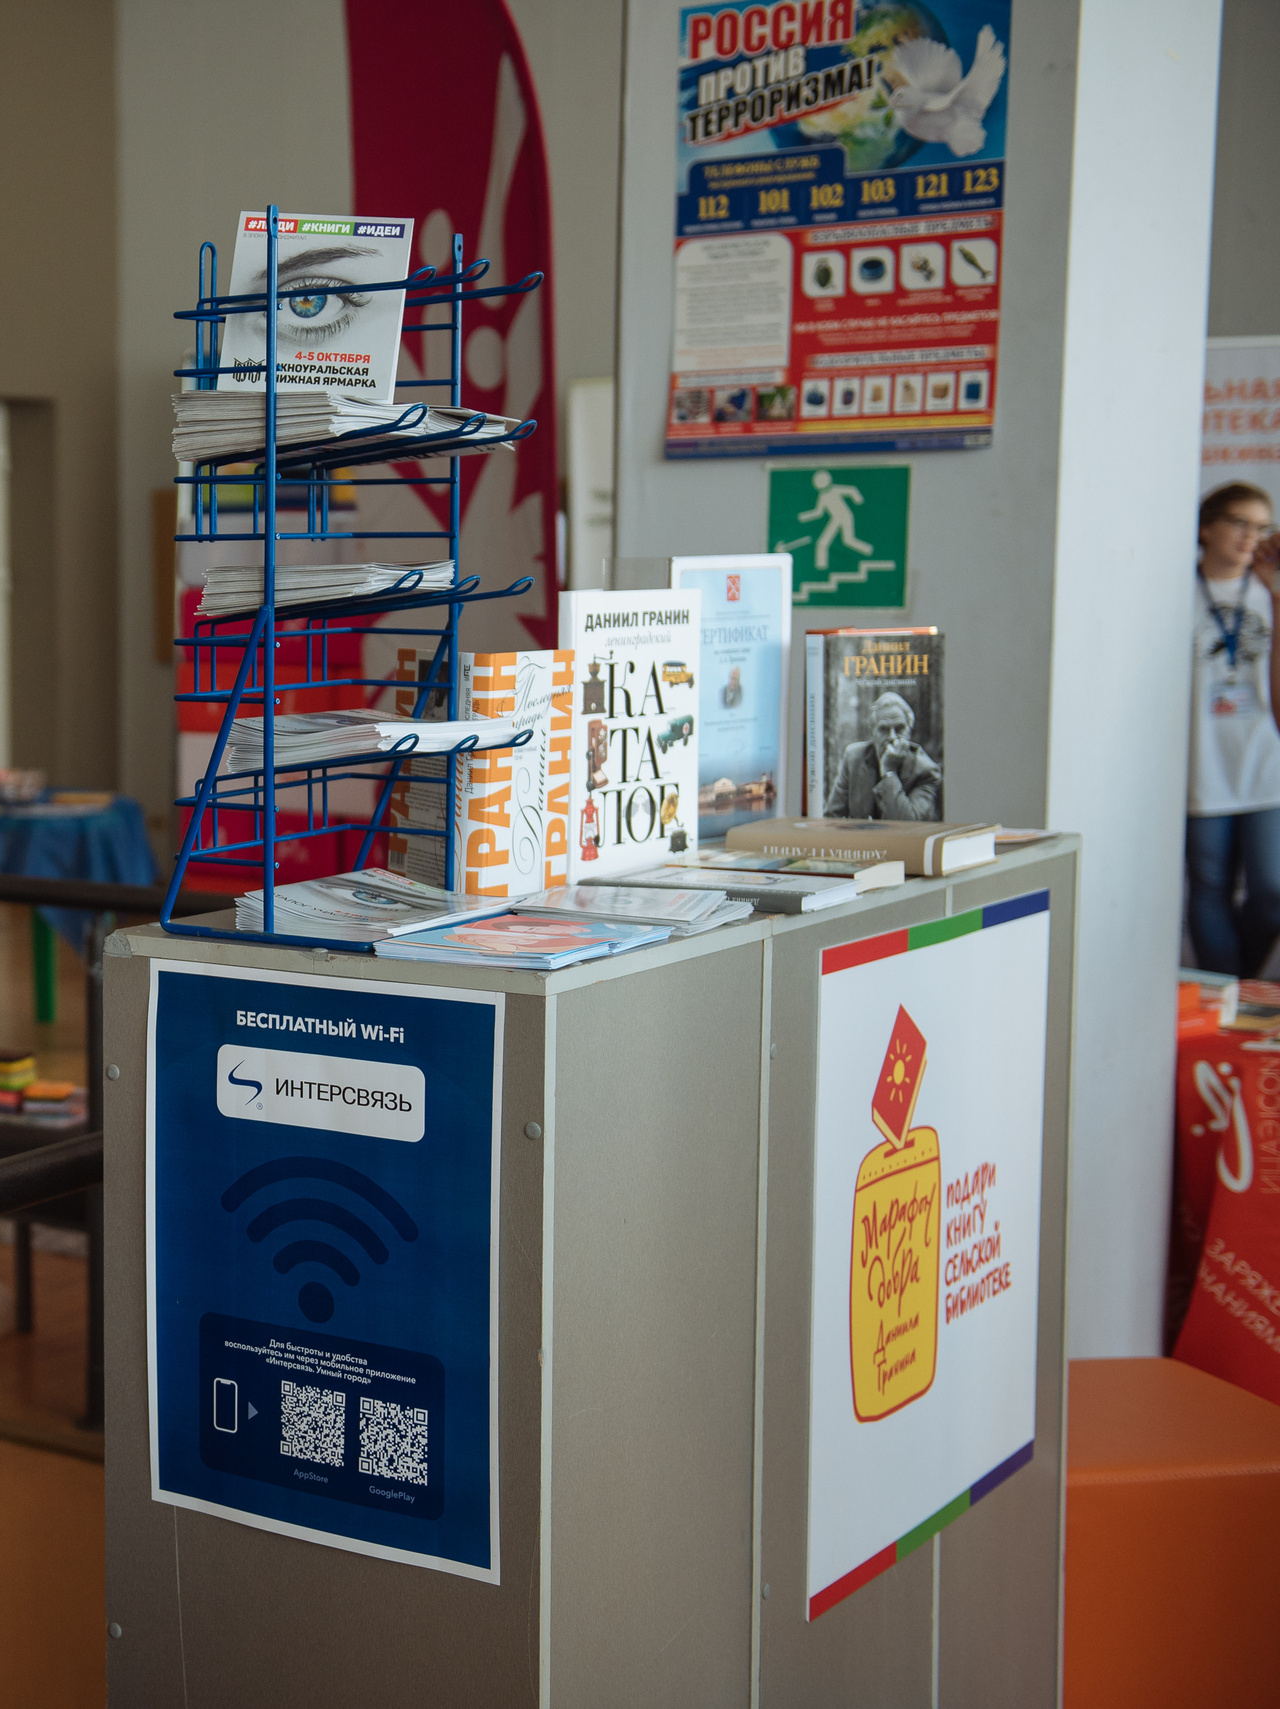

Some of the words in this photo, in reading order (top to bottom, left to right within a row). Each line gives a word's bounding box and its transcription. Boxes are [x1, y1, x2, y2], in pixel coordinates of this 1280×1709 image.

[688, 0, 856, 60] РОССИЯ
[697, 45, 808, 107] ПРОТИВ
[686, 56, 878, 144] ТЕРРОРИЗМА!
[860, 177, 896, 205] 103
[915, 172, 949, 199] 121
[963, 167, 999, 195] 123
[698, 194, 730, 221] 112
[758, 188, 790, 214] 101
[810, 183, 844, 210] 102
[247, 219, 295, 231] #ЛДИ
[301, 221, 351, 234] #КНИГИ
[357, 225, 401, 236] #ИДЕИ
[276, 363, 369, 376] ЖНОУРАЛЬСКАЯ
[295, 351, 315, 361] 4-5
[316, 353, 371, 364] ОКТЯБРЯ
[265, 374, 320, 385] ИЖНАЯ
[322, 377, 377, 388] ЯРМАРКА
[585, 611, 639, 632] ДАНИИЛ
[642, 609, 690, 627] ГРАНИН
[843, 654, 929, 676] ГРАНИН
[464, 687, 472, 721] СЛЕДНЯЯ
[605, 660, 668, 720] КА
[609, 725, 664, 784] ТА
[544, 649, 575, 890] ГРАНИН
[236, 1010, 357, 1039] БЕСПЛАТНЫЙ
[360, 1024, 404, 1043] Wi-Fi
[275, 1077, 412, 1112] ИНТЕРСВЯЗЬ
[945, 1220, 1001, 1287] СЕЛЬСКОЙ
[945, 1261, 1012, 1326] БИБЛИОТЕКЕ
[224, 1340, 283, 1358] воспользуйтесь
[284, 1351, 295, 1359] им
[296, 1355, 319, 1365] через
[320, 1358, 364, 1374] мобильное
[365, 1368, 416, 1385] приложение
[269, 1338, 284, 1350] Для
[286, 1341, 324, 1357] быстроты
[332, 1352, 368, 1366] удобства
[266, 1356, 315, 1373] «Интерсвязь.
[316, 1366, 342, 1378] Умный
[344, 1373, 372, 1385] город»
[293, 1468, 329, 1484] AppStore
[369, 1485, 416, 1504] GooglePlay
